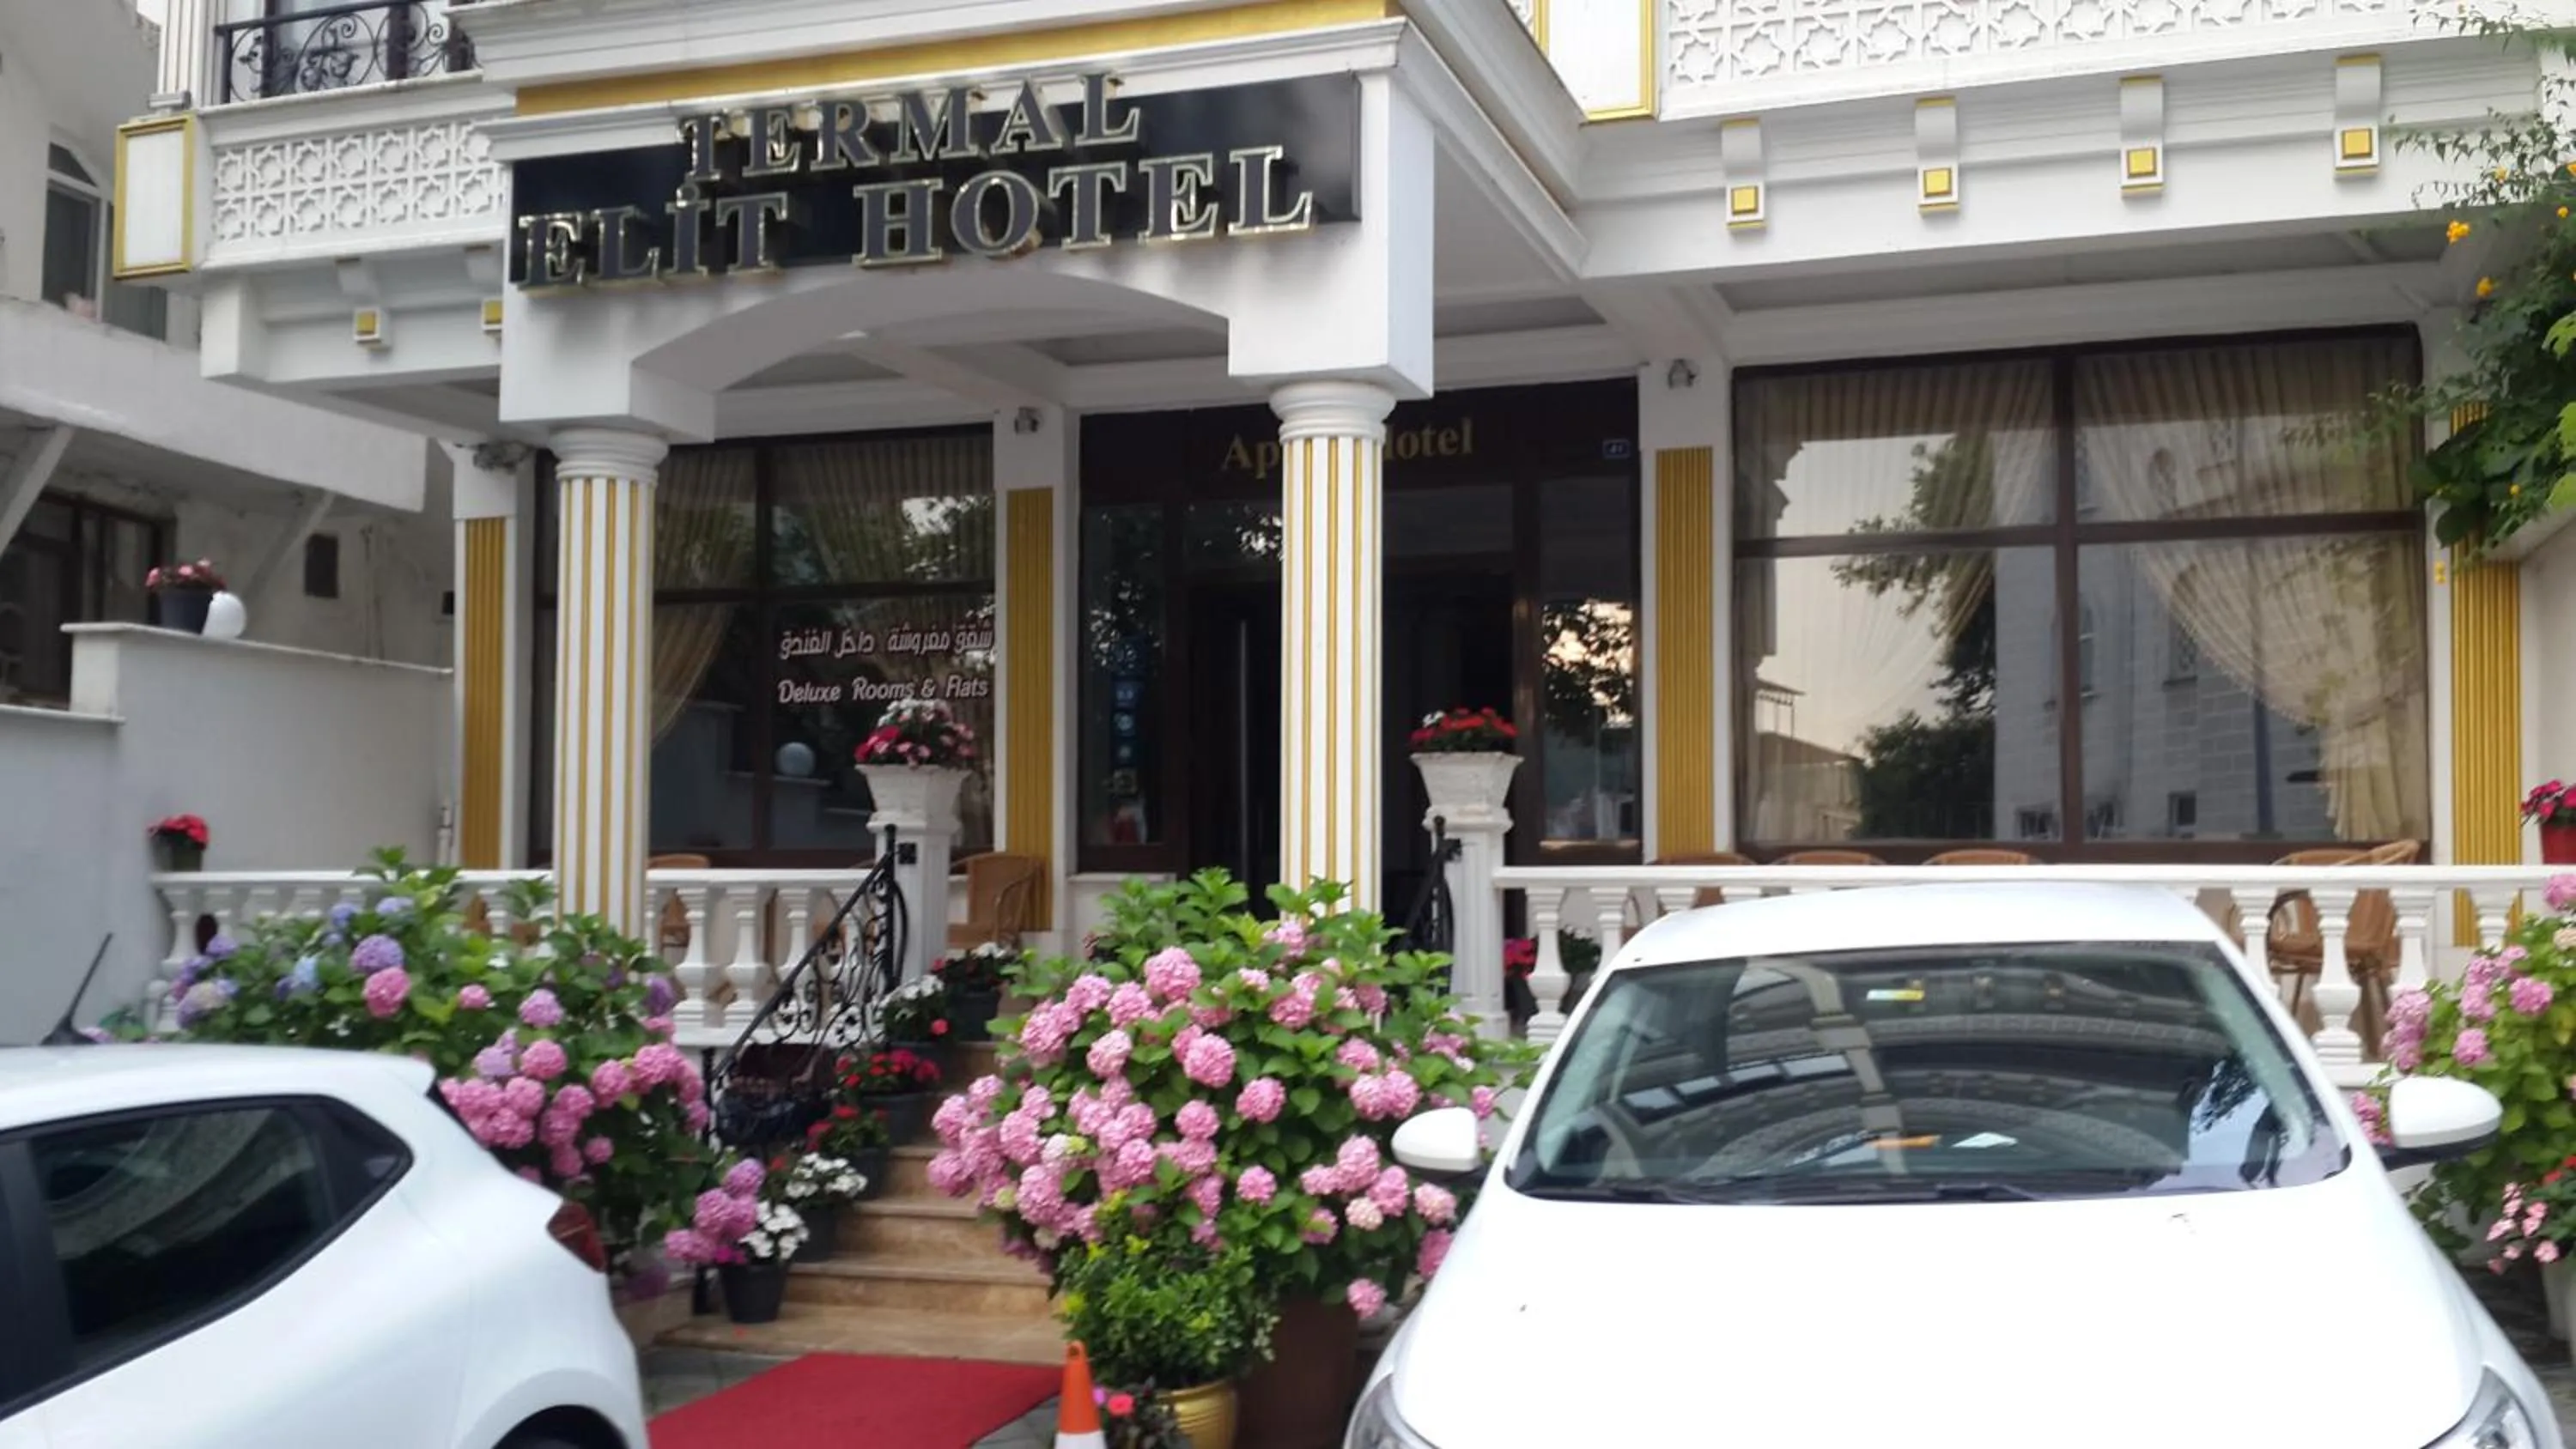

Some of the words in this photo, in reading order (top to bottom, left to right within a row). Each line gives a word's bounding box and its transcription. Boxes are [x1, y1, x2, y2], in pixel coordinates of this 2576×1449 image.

[677, 70, 1141, 182] TERMAL
[853, 144, 1314, 269] HOTEL
[779, 627, 833, 660] الفندق
[777, 679, 842, 704] Deluxe
[852, 676, 916, 701] Rooms
[920, 678, 936, 698] &
[945, 674, 989, 699] Flats
